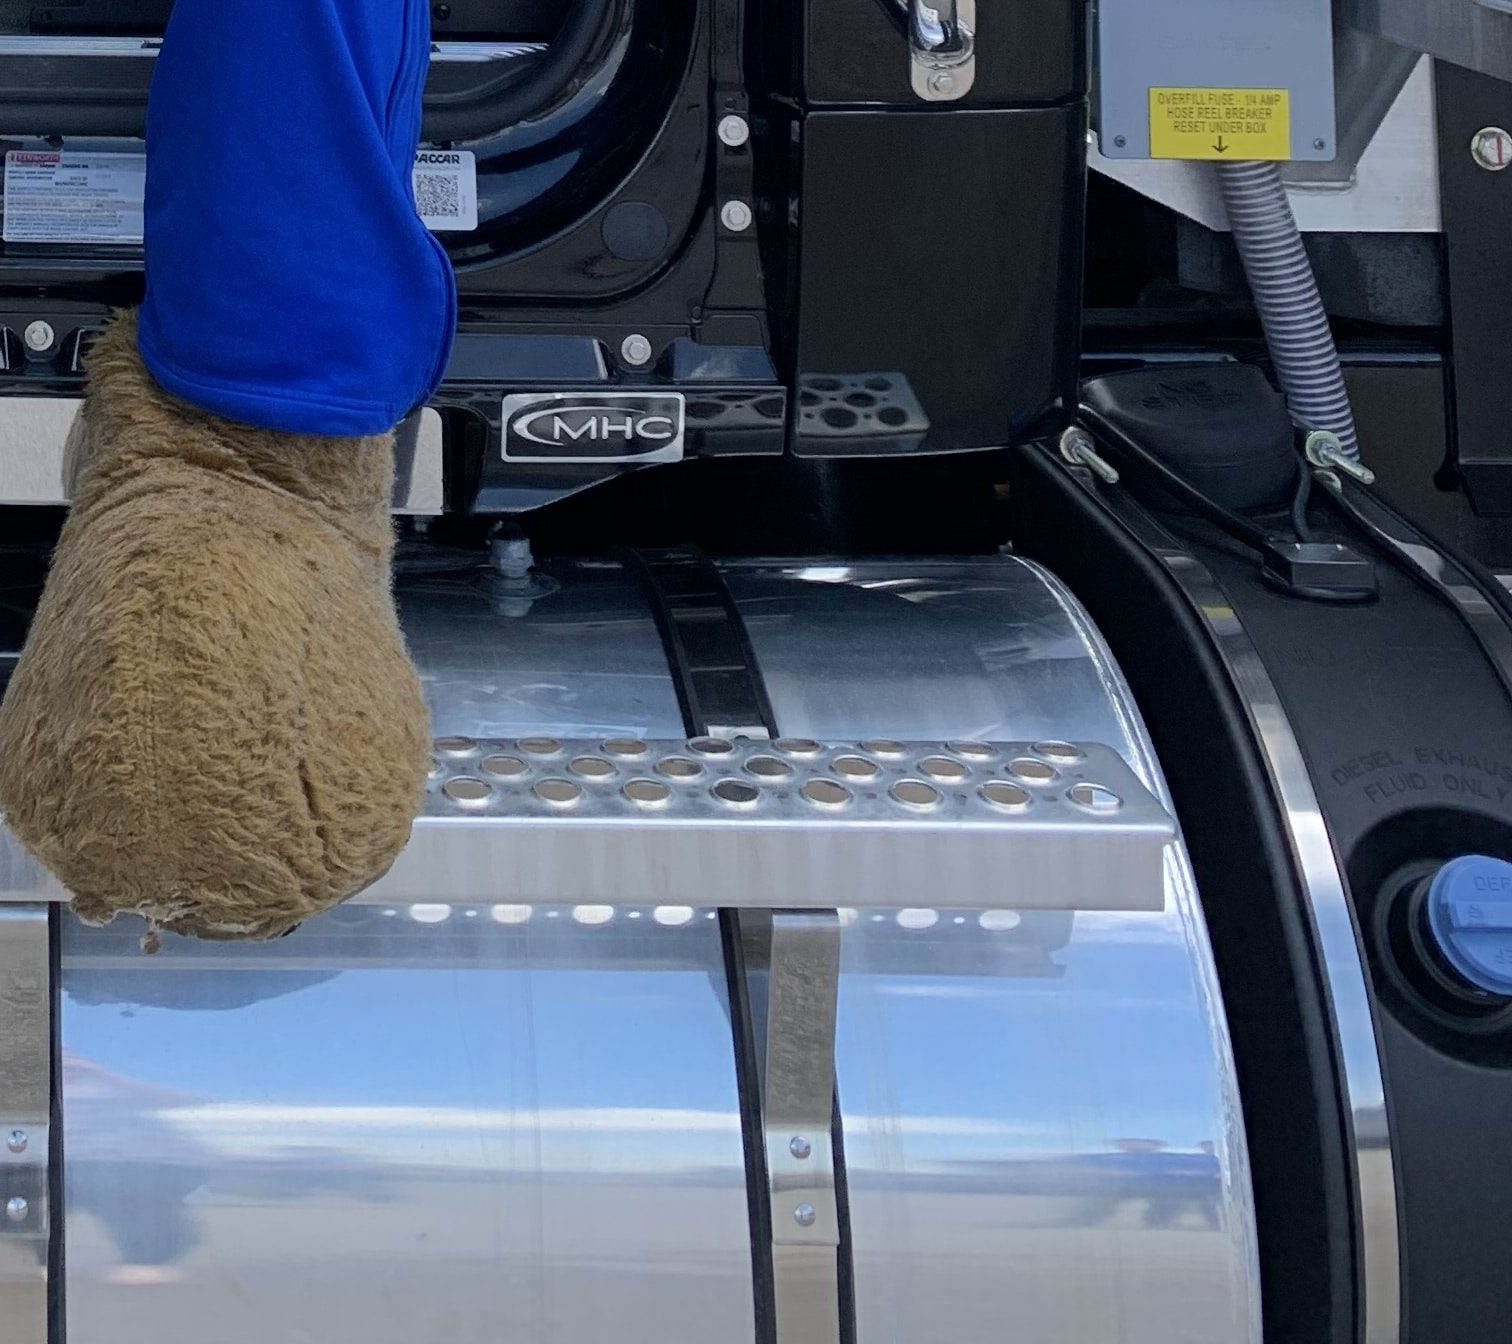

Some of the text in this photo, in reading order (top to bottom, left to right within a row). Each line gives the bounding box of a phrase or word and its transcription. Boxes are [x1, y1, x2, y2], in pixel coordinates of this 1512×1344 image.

[1157, 92, 1207, 105] OVERFILL
[1208, 93, 1234, 105] FUSE
[1260, 94, 1281, 105] AMP
[1167, 107, 1272, 120] HOSE REEL BREAKER
[1174, 121, 1267, 133] RESET UNDER BOX
[552, 415, 673, 441] MHC
[1331, 750, 1404, 787] DIESEL
[1364, 772, 1511, 803] FLUID ONLY
